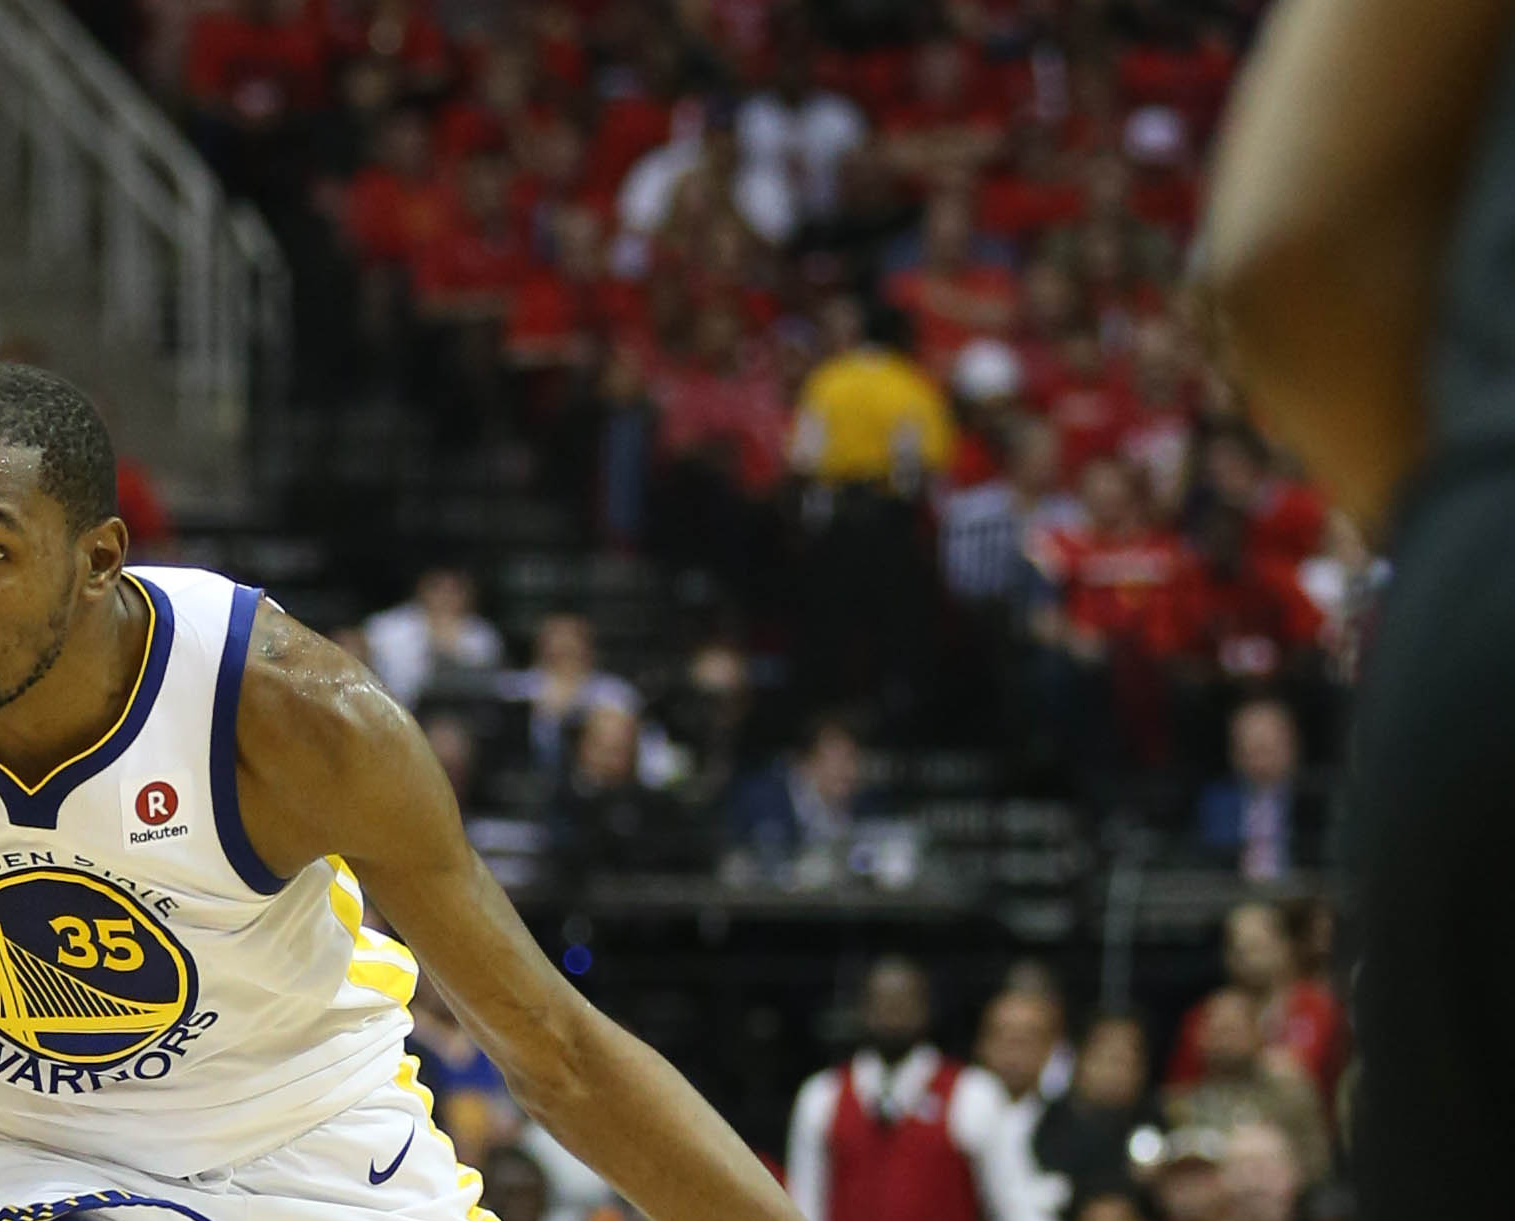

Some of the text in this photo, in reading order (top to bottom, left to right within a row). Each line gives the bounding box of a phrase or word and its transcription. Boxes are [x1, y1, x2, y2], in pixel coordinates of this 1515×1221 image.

[147, 790, 169, 818] R
[129, 824, 189, 845] Rakuten
[73, 854, 180, 918] STE
[49, 915, 145, 972] 35
